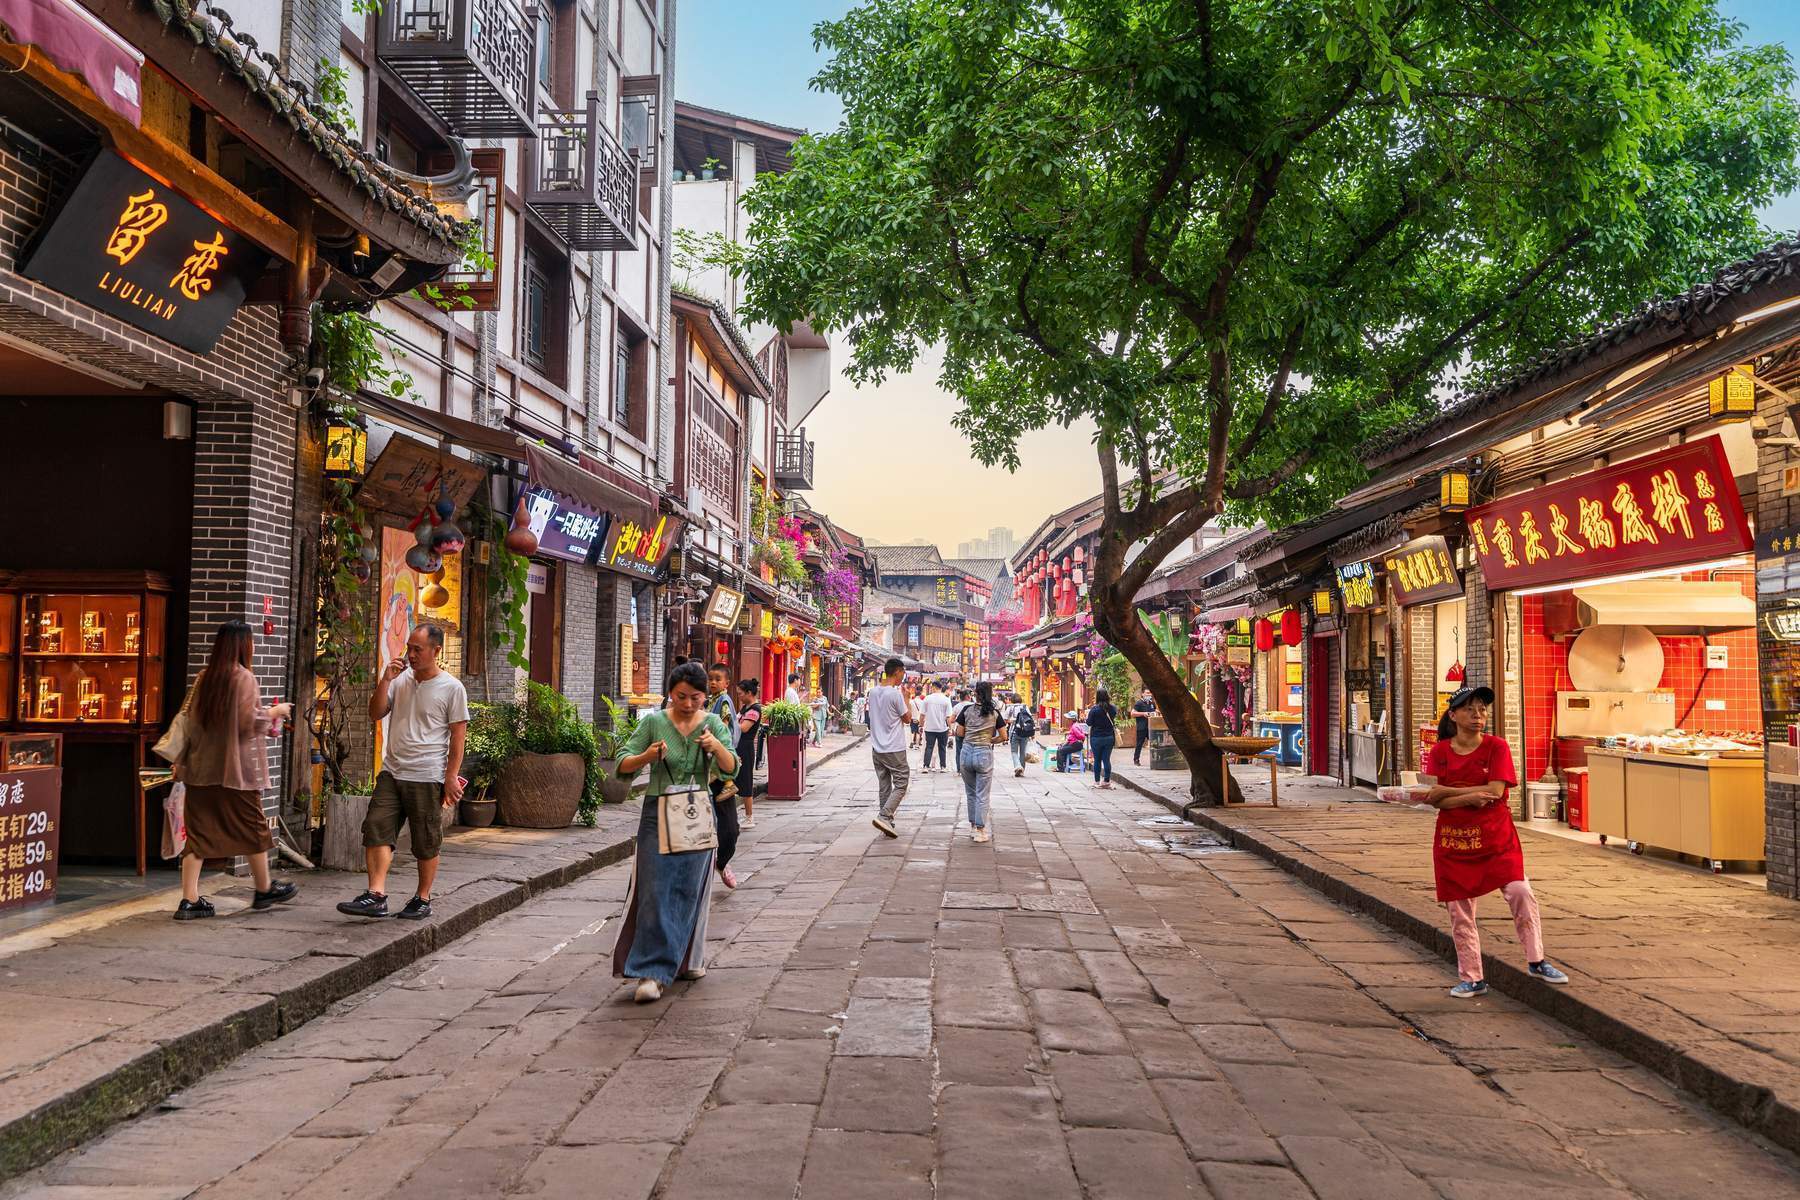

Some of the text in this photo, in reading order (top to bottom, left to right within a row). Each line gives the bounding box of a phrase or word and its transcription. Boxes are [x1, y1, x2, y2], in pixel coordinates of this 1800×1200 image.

[106, 188, 229, 301] 留恋
[98, 270, 178, 321] LIULIAN
[555, 511, 600, 542] 一只酸奶牛
[1491, 468, 1695, 569] 重庆火锅底料
